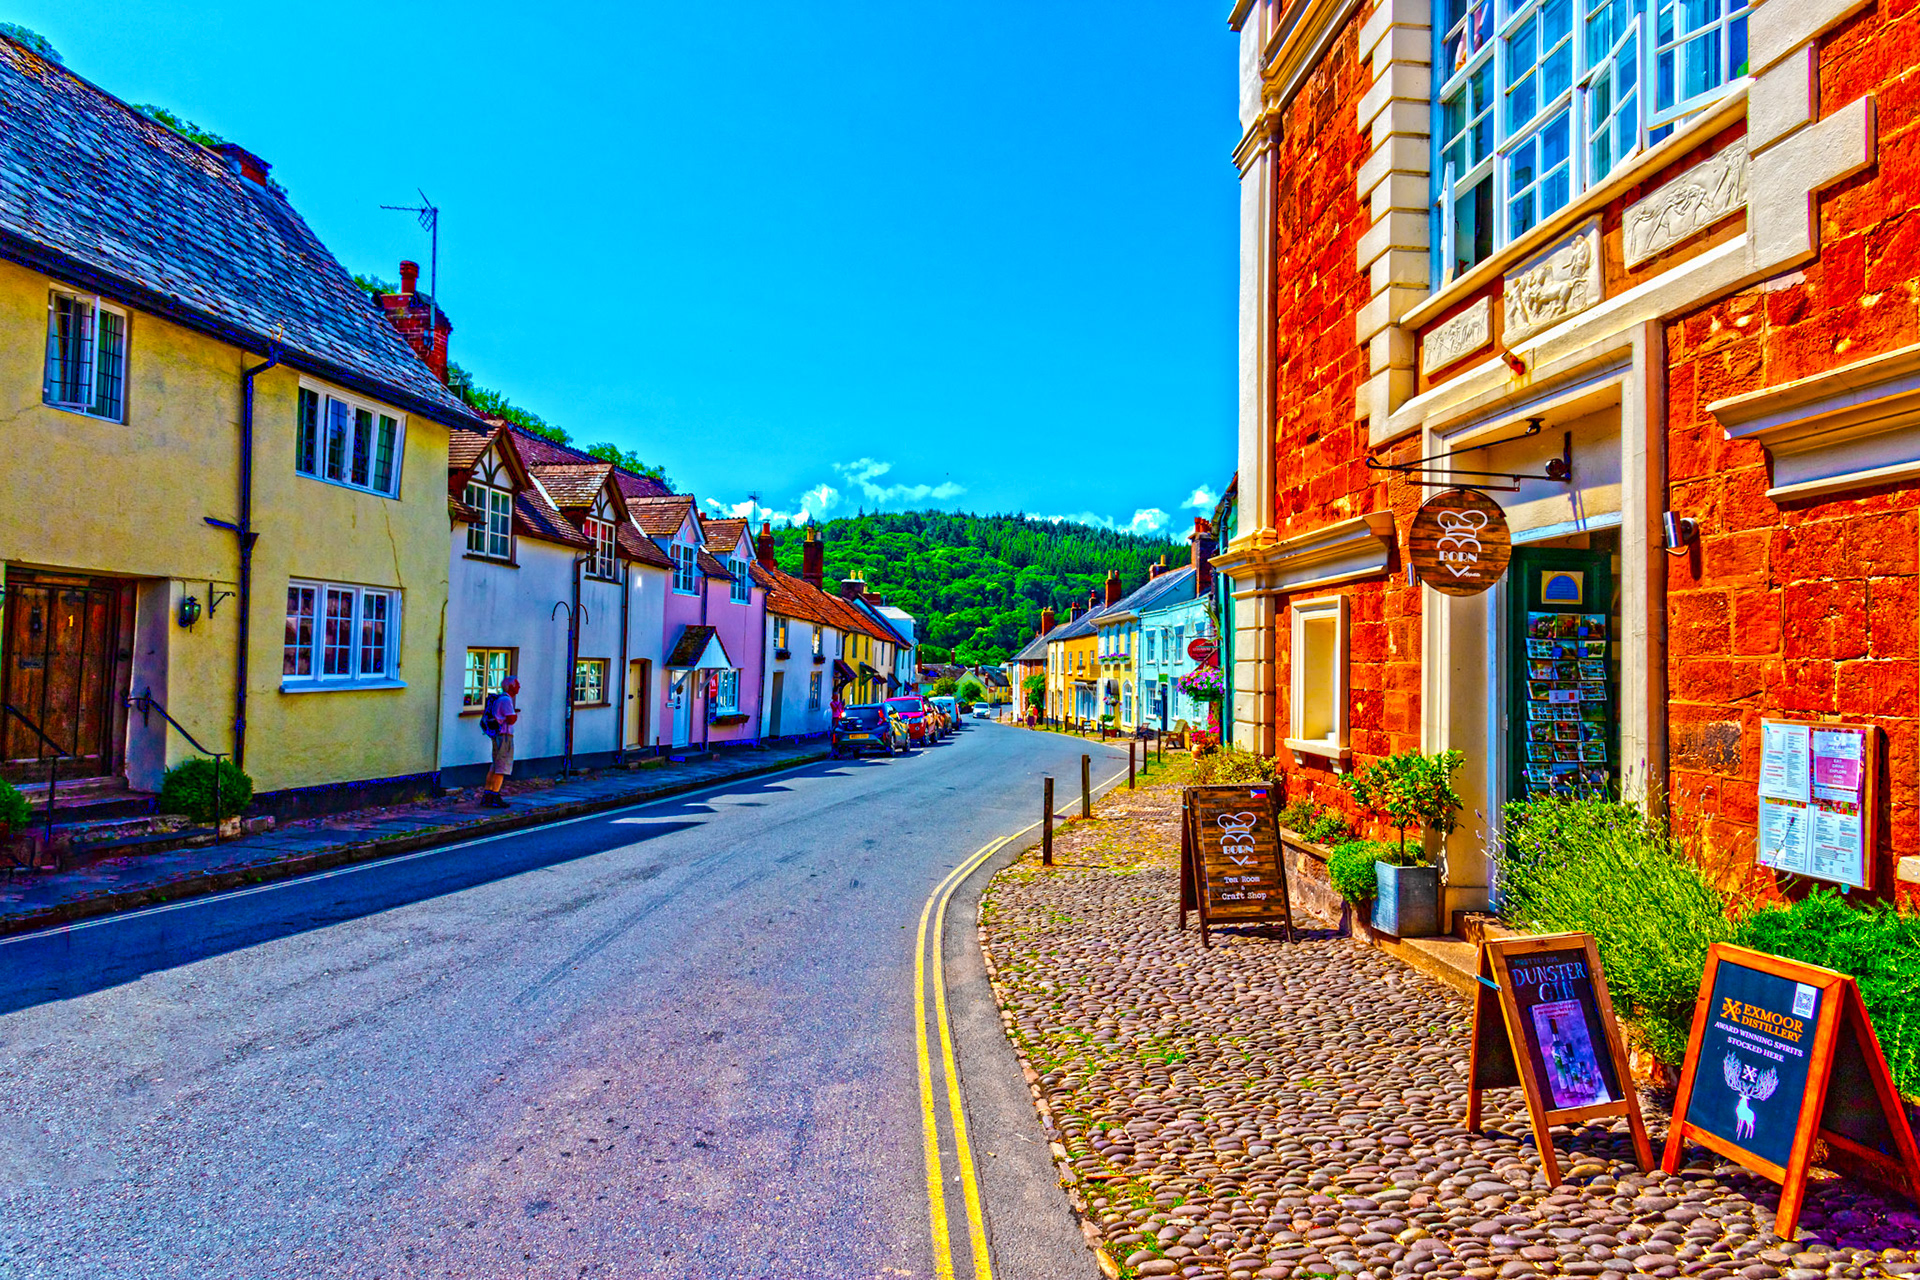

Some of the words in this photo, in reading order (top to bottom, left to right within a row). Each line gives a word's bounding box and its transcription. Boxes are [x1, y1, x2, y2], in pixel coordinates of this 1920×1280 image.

[1439, 551, 1478, 563] BORN
[68, 614, 74, 627] 1
[1223, 845, 1253, 854] BORN
[1222, 892, 1245, 900] Craft
[1247, 892, 1267, 900] Shop
[1512, 962, 1586, 986] DUNSTER
[1538, 980, 1576, 1003] GIN
[1741, 1015, 1803, 1043] DISTILLERY
[1743, 1004, 1803, 1033] EXMOOR
[1714, 1021, 1740, 1035] AWARD
[1739, 1029, 1774, 1047] WINNING
[1773, 1040, 1804, 1058] SPIRITS
[1727, 1036, 1763, 1054] STOCKED
[1762, 1048, 1785, 1063] HERE
